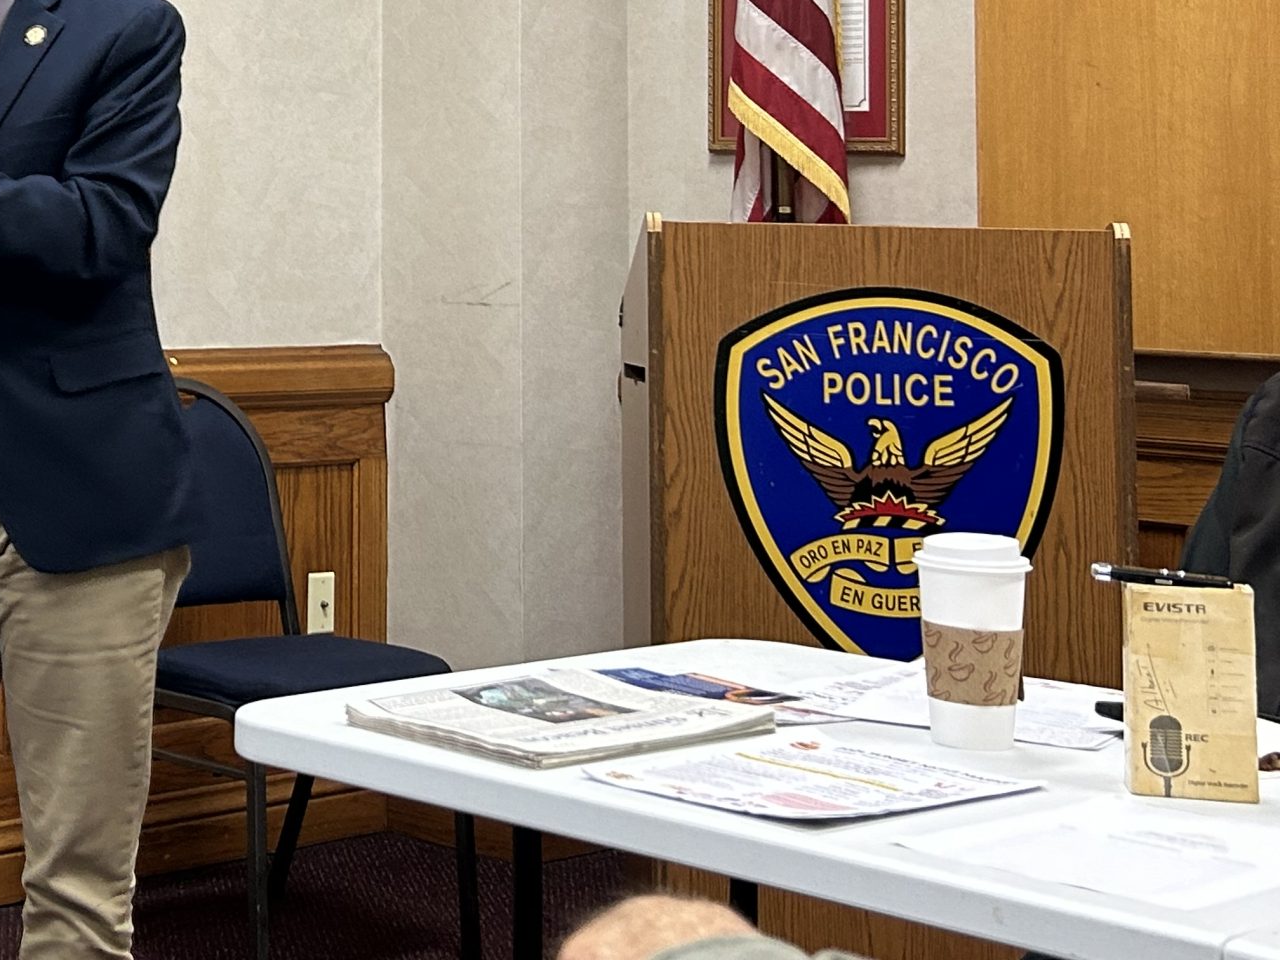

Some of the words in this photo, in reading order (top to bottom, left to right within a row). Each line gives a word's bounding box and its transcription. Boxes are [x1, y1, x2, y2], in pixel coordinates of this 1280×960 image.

[756, 334, 823, 390] SAN
[826, 319, 1021, 395] FRANCISCO
[823, 372, 956, 407] POLICE
[799, 544, 828, 569] ORO
[831, 538, 852, 555] EN
[856, 538, 884, 557] PAZ
[840, 586, 865, 606] EN
[871, 593, 921, 612] GUER
[1143, 602, 1207, 614] EVISTA
[1185, 733, 1209, 742] REC
